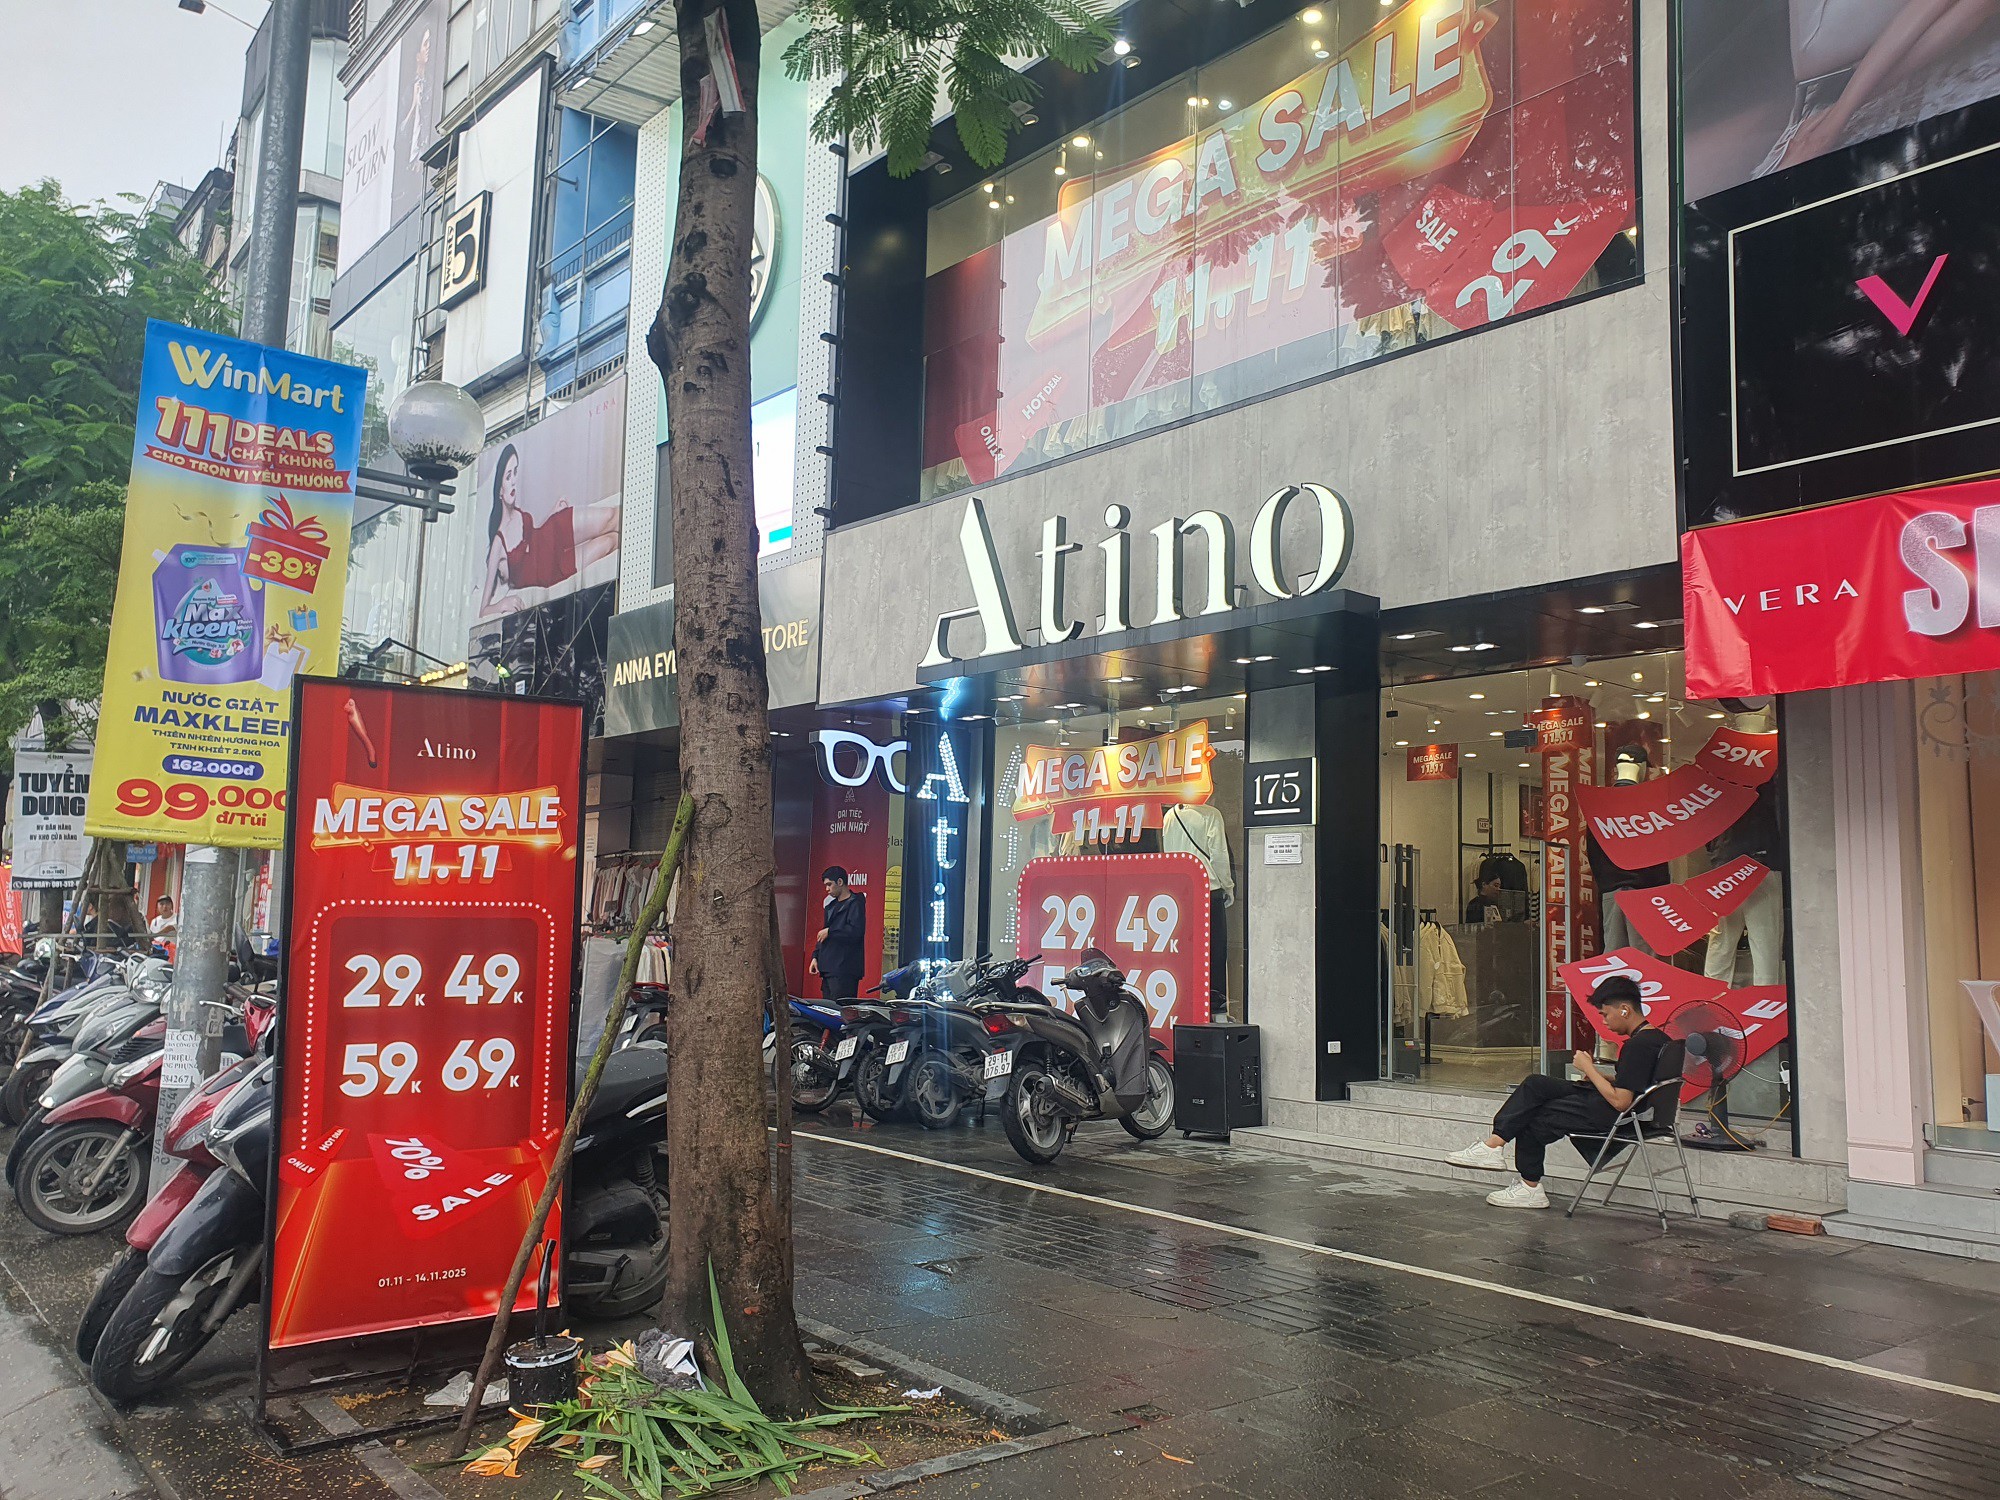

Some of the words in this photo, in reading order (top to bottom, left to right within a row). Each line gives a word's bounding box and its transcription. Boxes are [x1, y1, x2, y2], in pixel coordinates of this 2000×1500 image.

[346, 118, 381, 175] SLOW
[1043, 129, 1238, 297] MEGA
[1256, 0, 1464, 172] SALE
[355, 139, 389, 193] TURN
[452, 208, 475, 284] 5
[1415, 207, 1459, 252] SALE
[1153, 216, 1316, 350] 11.11
[168, 341, 344, 414] WinMart
[1022, 392, 1047, 420] HOT
[1042, 374, 1062, 395] DEAL
[155, 396, 231, 459] 111
[234, 421, 335, 454] DEALS
[152, 450, 185, 465] CHO
[189, 458, 230, 477] TRỌN
[233, 469, 249, 482] VỊ
[252, 469, 281, 483] YÊU
[284, 472, 344, 489] THƯƠNG
[231, 445, 275, 463] CHẤT
[278, 452, 336, 470] KHỦNG
[249, 551, 317, 579] -39%
[917, 482, 1354, 667] Atino
[1723, 578, 1859, 615] VERA
[612, 656, 652, 687] ANNA
[763, 619, 809, 654] TORE
[162, 690, 221, 709] NƯỚC
[225, 697, 279, 715] GIẶT
[152, 729, 186, 739] THIÊN
[187, 732, 221, 743] NHIÊN
[222, 736, 258, 746] HƯƠNG
[259, 740, 280, 748] HOA
[1542, 730, 1574, 744] 11.11
[1560, 717, 1584, 729] SALE
[169, 742, 197, 752] TINH
[198, 745, 231, 755] KHIẾT
[417, 737, 477, 761] Atino
[1018, 750, 1109, 797] MEGA
[1117, 734, 1204, 783] SALE
[1413, 754, 1434, 764] MEGA
[1434, 751, 1452, 762] SALE
[1711, 741, 1772, 768] 29K
[19, 763, 90, 794] TUYỂN
[172, 758, 256, 777] 162.000đ
[1420, 762, 1445, 774] 11.11
[1254, 771, 1301, 805] 175
[1549, 755, 1570, 832] MEGA
[22, 795, 86, 821] DỤNG
[314, 797, 448, 834] MEGA
[459, 797, 561, 832] SALE
[1072, 804, 1145, 842] 11.11
[1593, 811, 1674, 839] MEGA
[1666, 783, 1723, 821] SALE
[829, 822, 846, 834] SINH
[391, 844, 500, 880] 11.11
[847, 869, 867, 886] KÍNH
[1706, 875, 1738, 900] HOT
[1735, 863, 1758, 881] DEAL
[1041, 894, 1096, 950] 29K
[1115, 894, 1179, 953] 49K
[1651, 896, 1693, 933] ATINO
[343, 953, 425, 1008] 29K
[444, 953, 523, 1006] 49K
[339, 1040, 421, 1098] 59K
[441, 1037, 520, 1093] 69K
[985, 1064, 1010, 1078] 076.97
[287, 1157, 316, 1174] ATINO
[385, 1137, 446, 1180] 10%
[411, 1172, 513, 1221] SALE
[378, 1276, 403, 1288] 01.11
[415, 1268, 467, 1283] 14.11.2025
